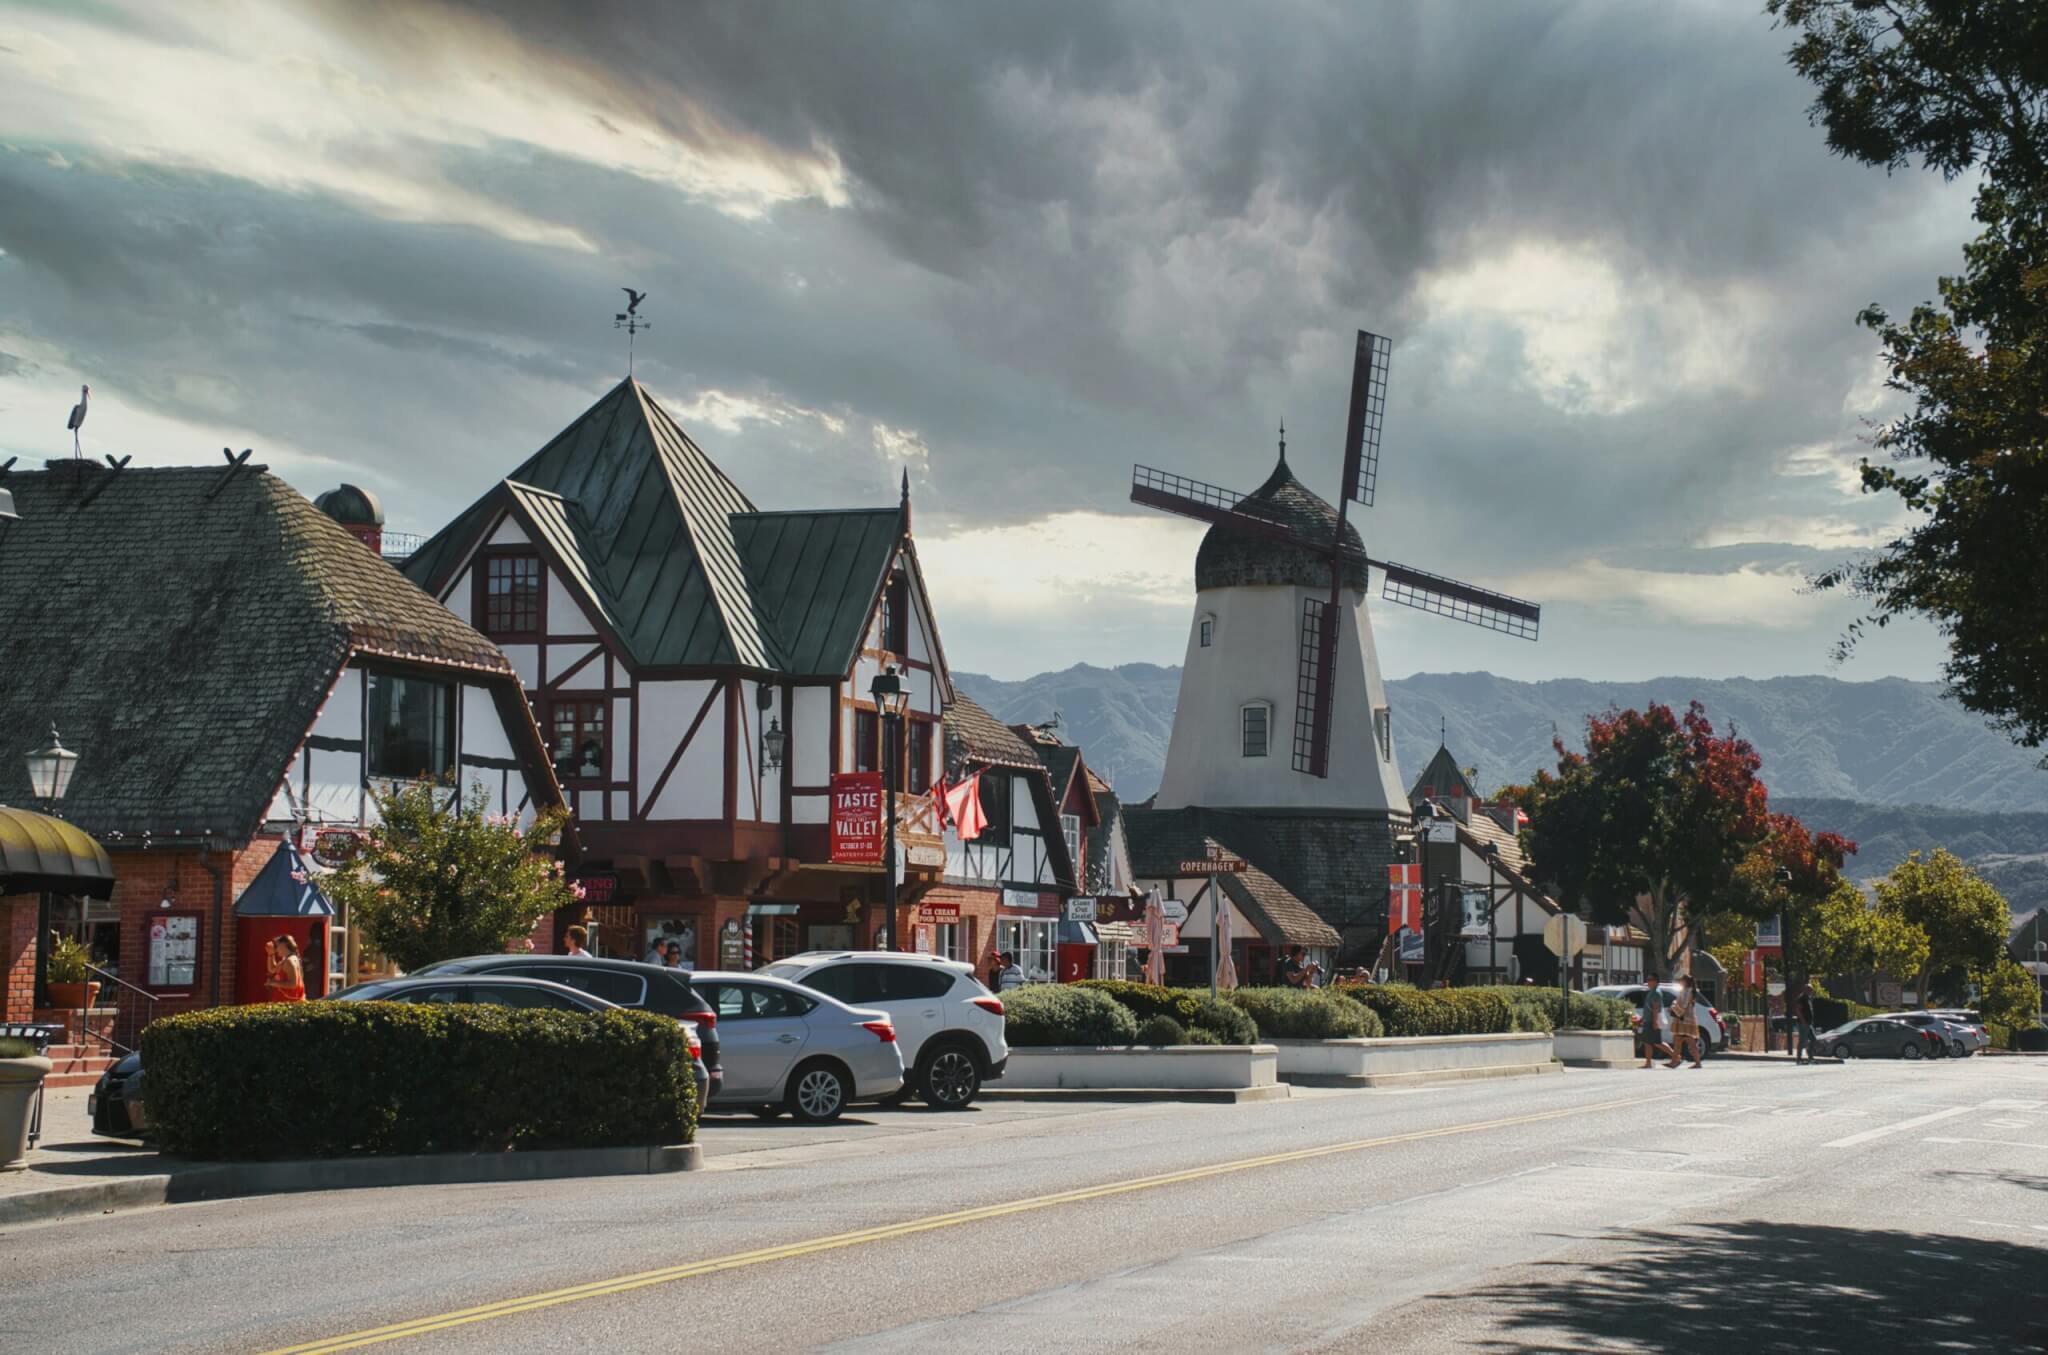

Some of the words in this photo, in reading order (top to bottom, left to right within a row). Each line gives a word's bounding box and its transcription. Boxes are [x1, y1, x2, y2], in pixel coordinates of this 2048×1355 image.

[837, 793, 877, 808] TASTE
[836, 820, 877, 836] VALLEY
[1180, 862, 1235, 872] COPENHAGEN
